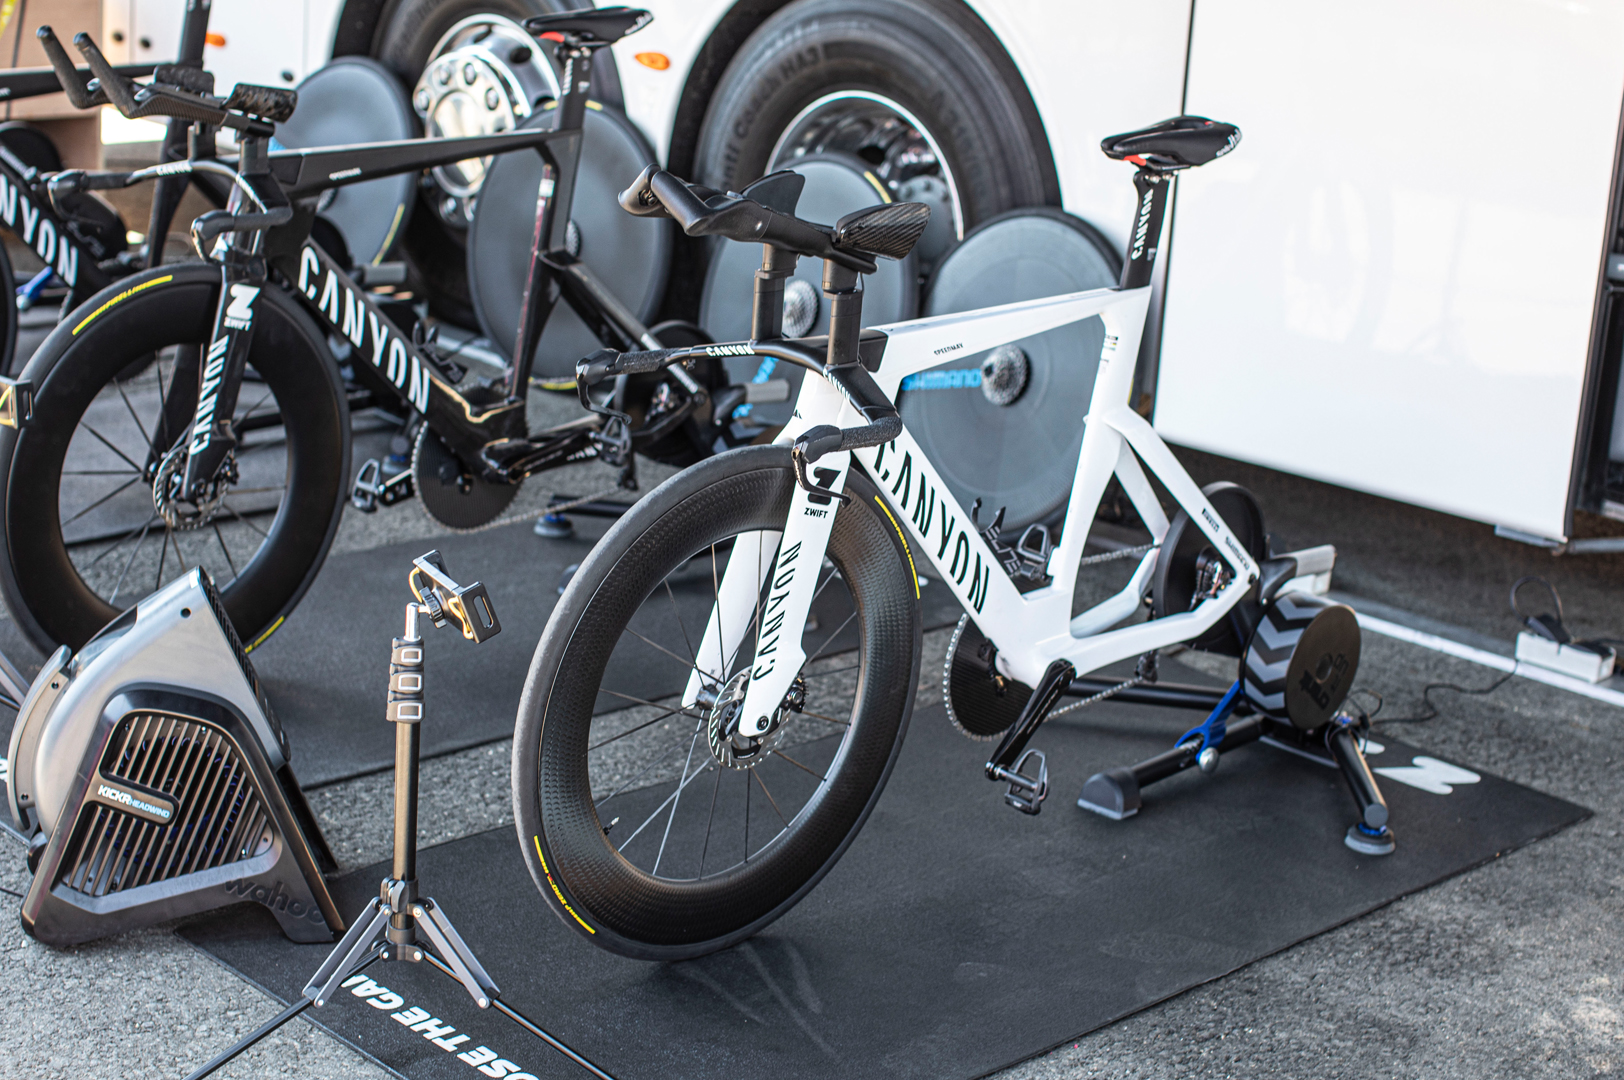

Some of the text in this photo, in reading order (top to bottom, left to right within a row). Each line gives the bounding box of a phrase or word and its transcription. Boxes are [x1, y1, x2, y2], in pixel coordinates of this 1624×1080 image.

[1130, 189, 1154, 260] CANYON
[297, 246, 430, 414] CANYON
[705, 345, 755, 357] CANYON
[933, 342, 964, 356] SPEEDMAX
[189, 334, 230, 456] CANYON
[803, 507, 829, 519] ZWIFT
[874, 440, 990, 615] CANYON
[752, 540, 802, 681] CANYON
[224, 880, 327, 925] wahoo
[390, 1006, 471, 1052] THE
